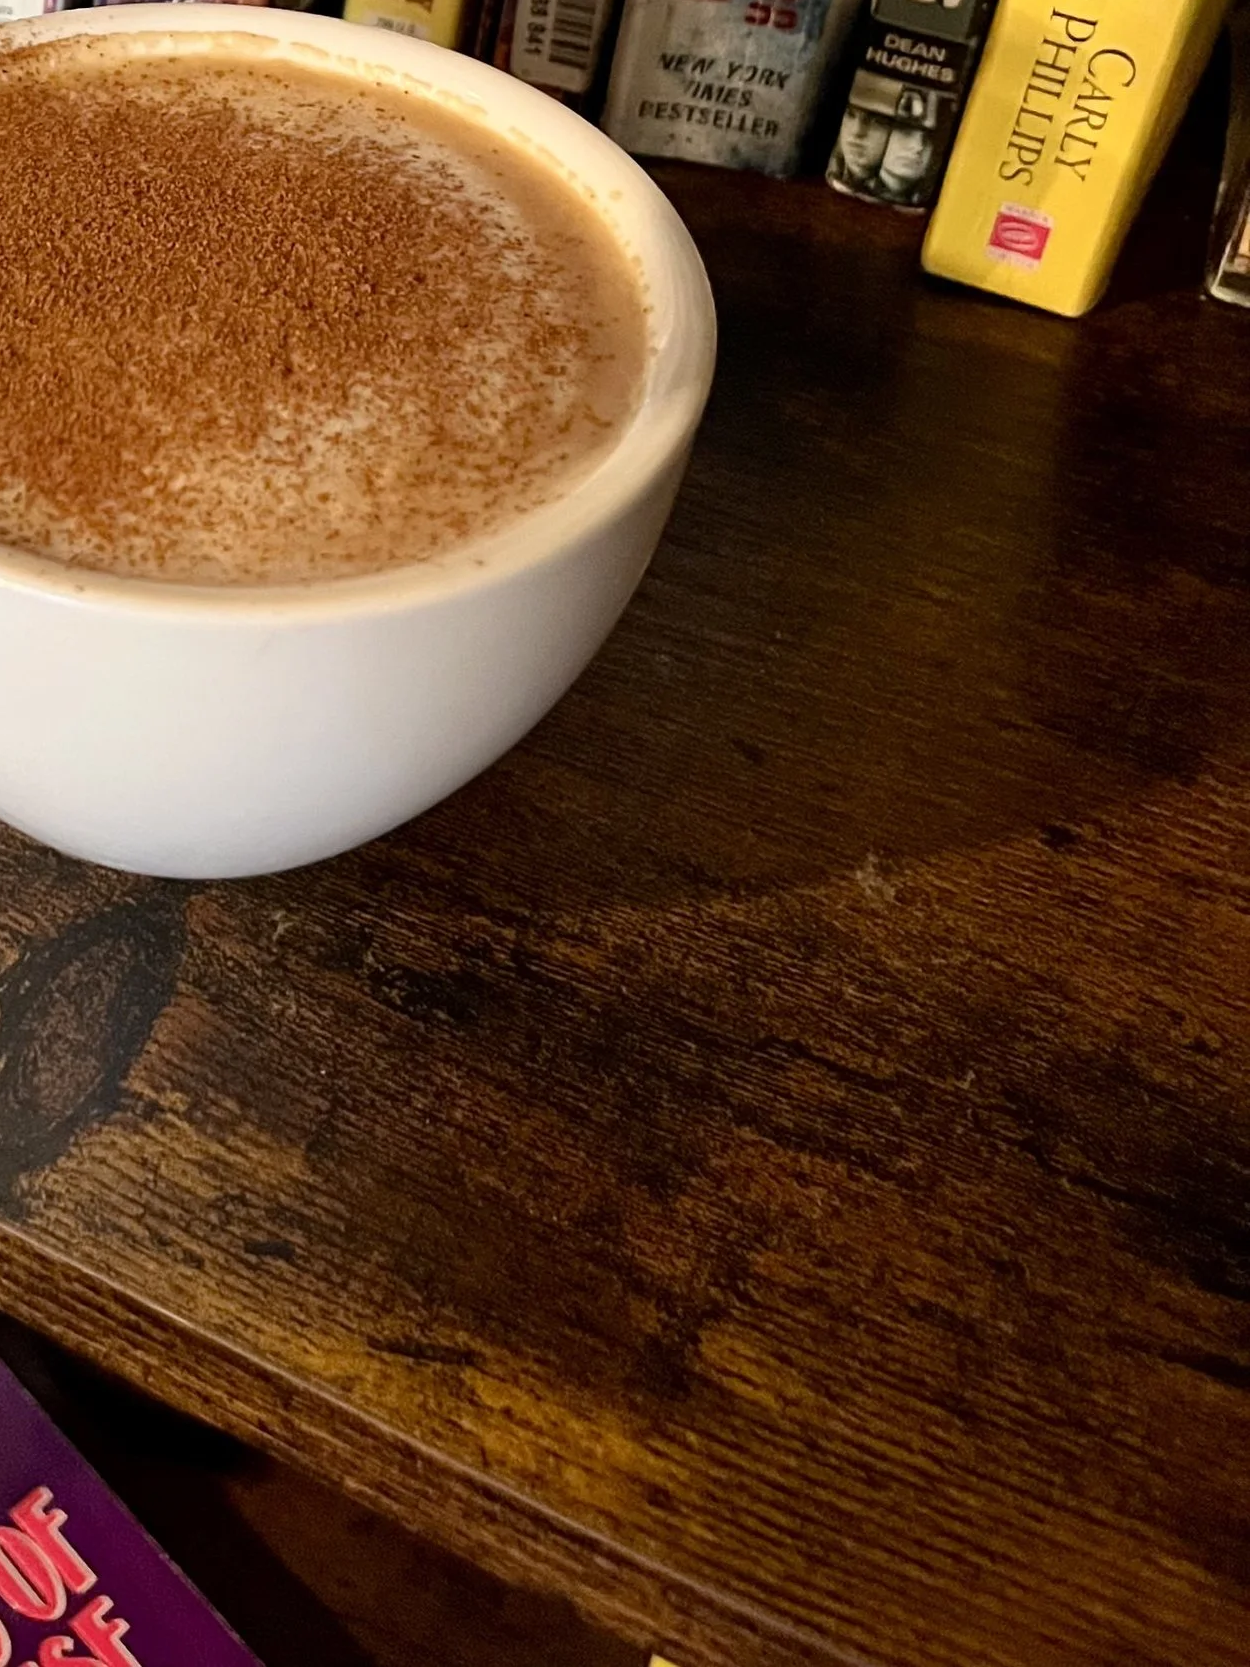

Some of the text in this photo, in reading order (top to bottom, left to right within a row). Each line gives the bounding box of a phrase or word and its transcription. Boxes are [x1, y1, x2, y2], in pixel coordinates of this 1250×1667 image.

[865, 45, 955, 84] HUGHES
[884, 33, 947, 63] DEAN
[658, 52, 791, 92] NEW YORK
[998, 6, 1100, 187] PHILLIPS
[1054, 47, 1137, 183] CARLY
[638, 99, 780, 138] BESTSELLER
